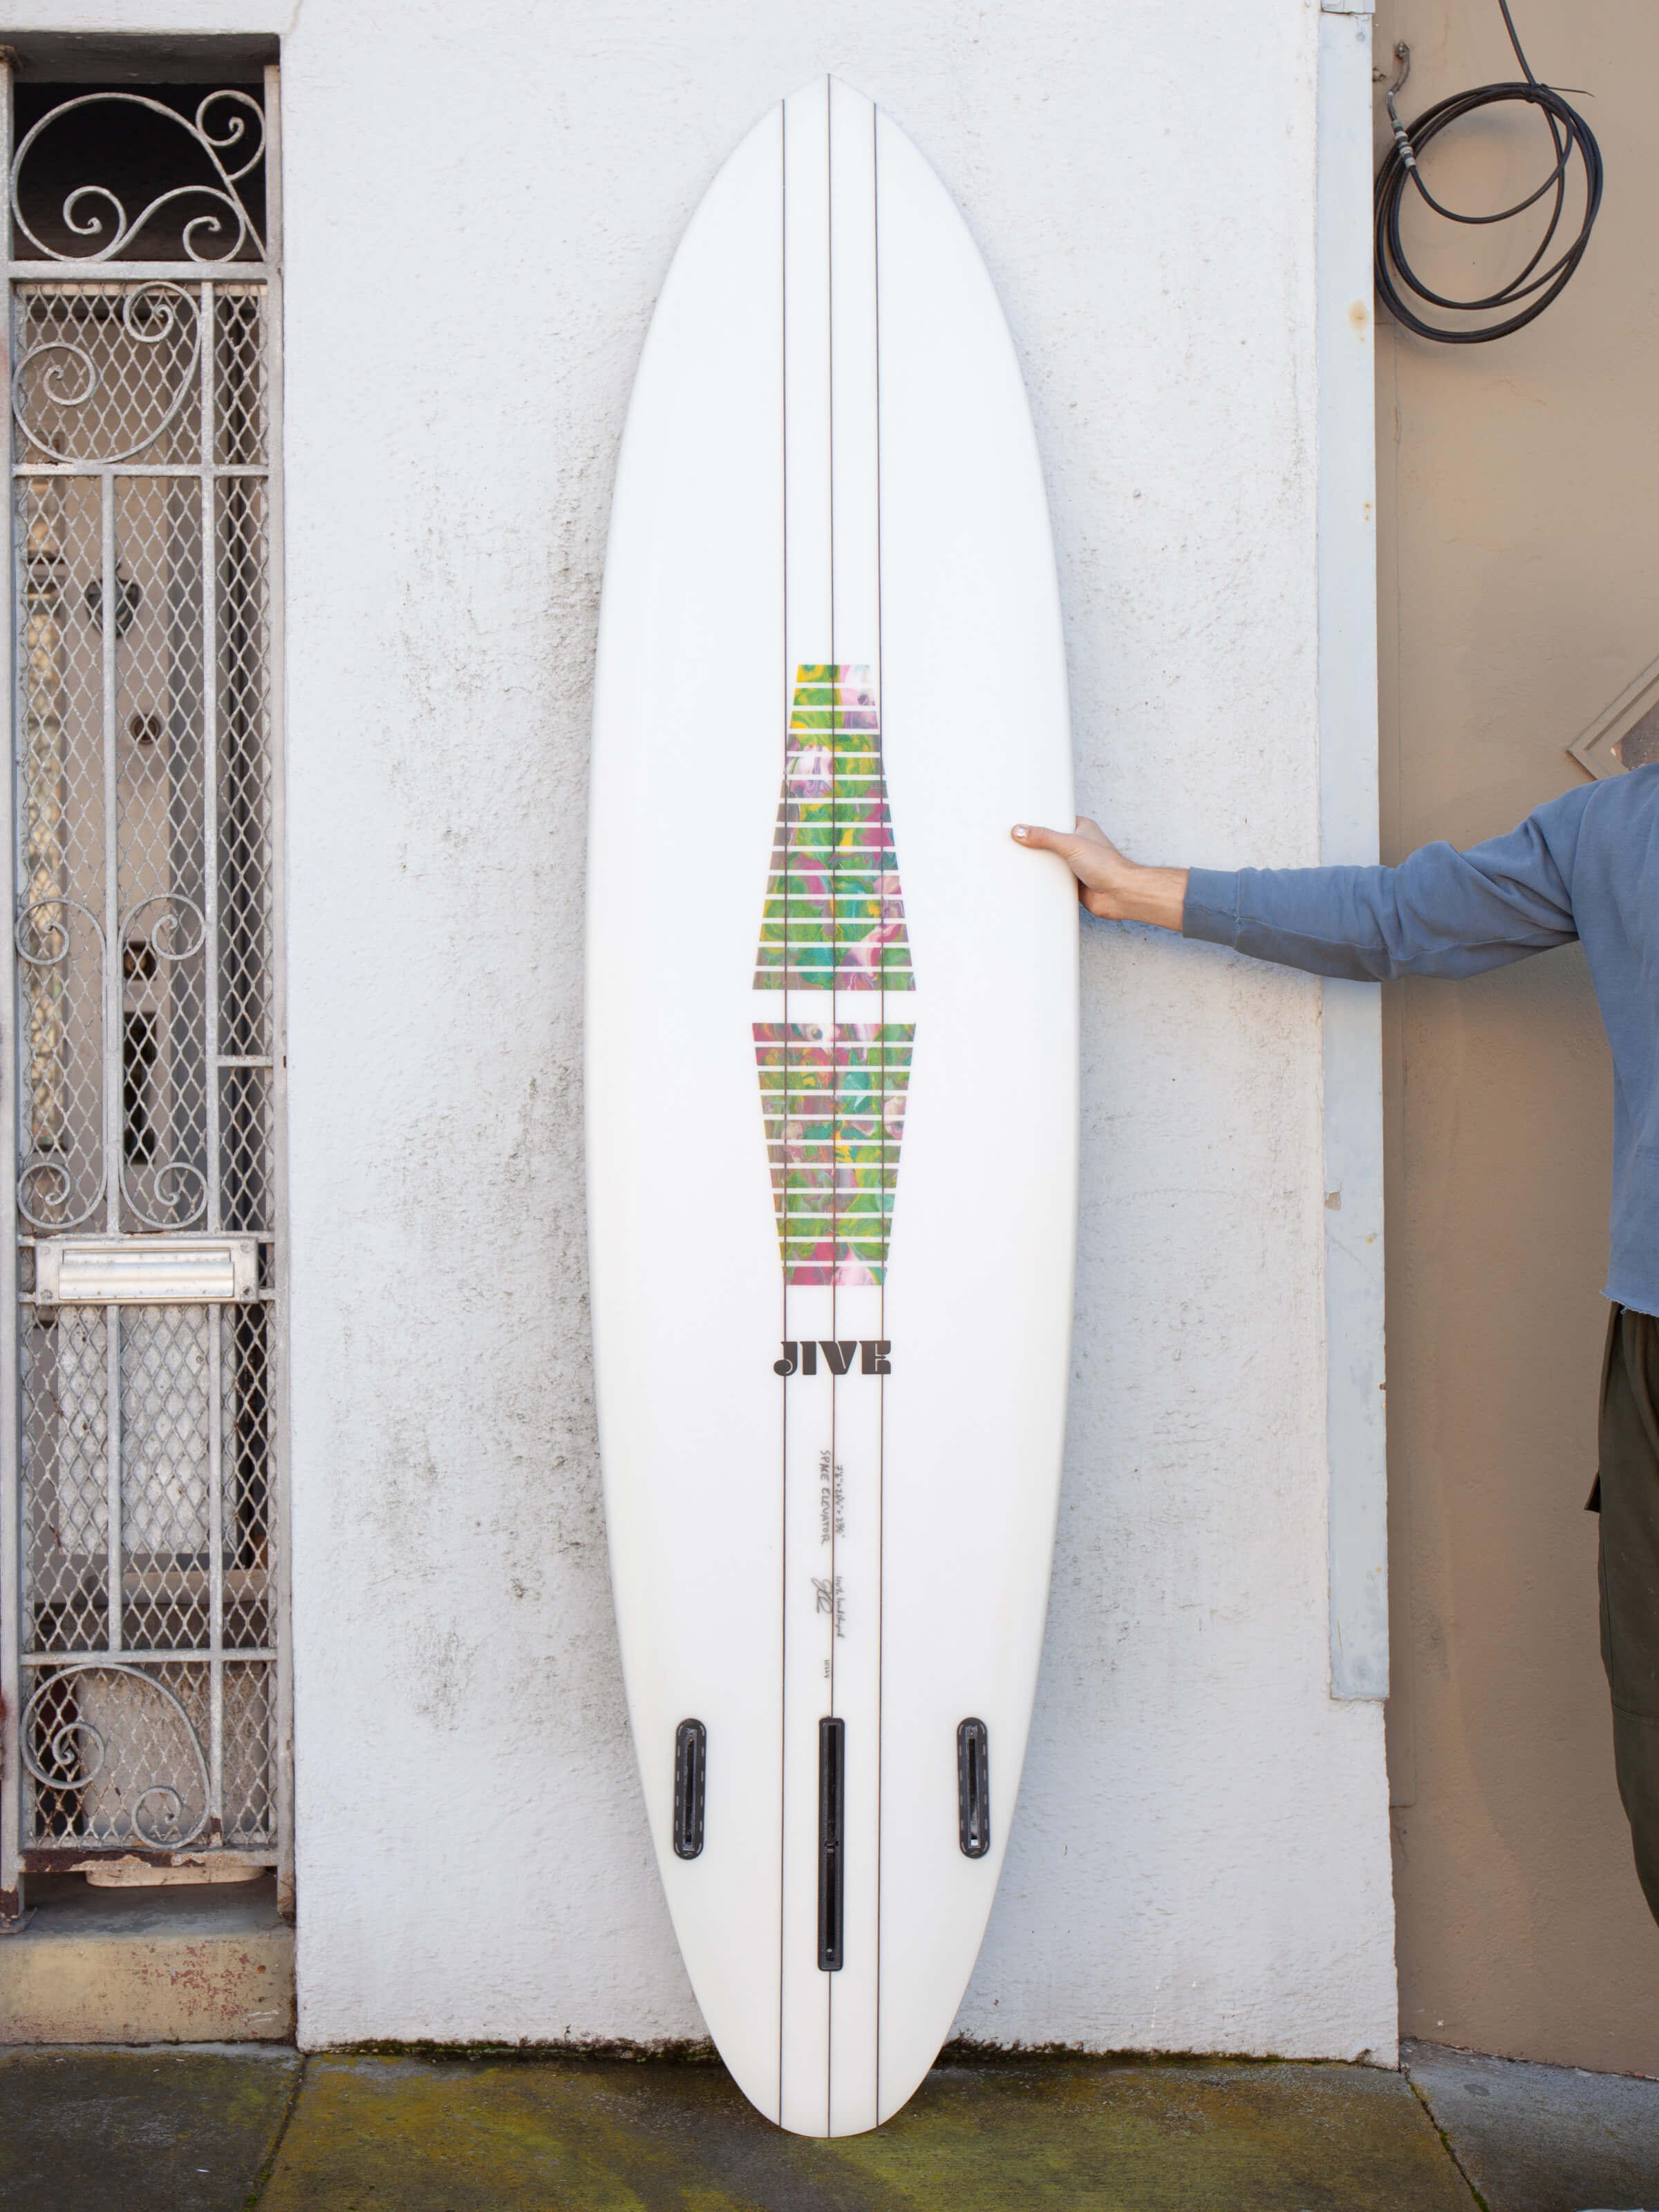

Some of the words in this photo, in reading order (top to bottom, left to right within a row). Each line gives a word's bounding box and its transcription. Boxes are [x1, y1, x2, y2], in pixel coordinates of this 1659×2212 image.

[774, 1340, 891, 1376] JIVE
[818, 1449, 830, 1481] SPACE
[821, 1488, 831, 1545] ELEVATOR
